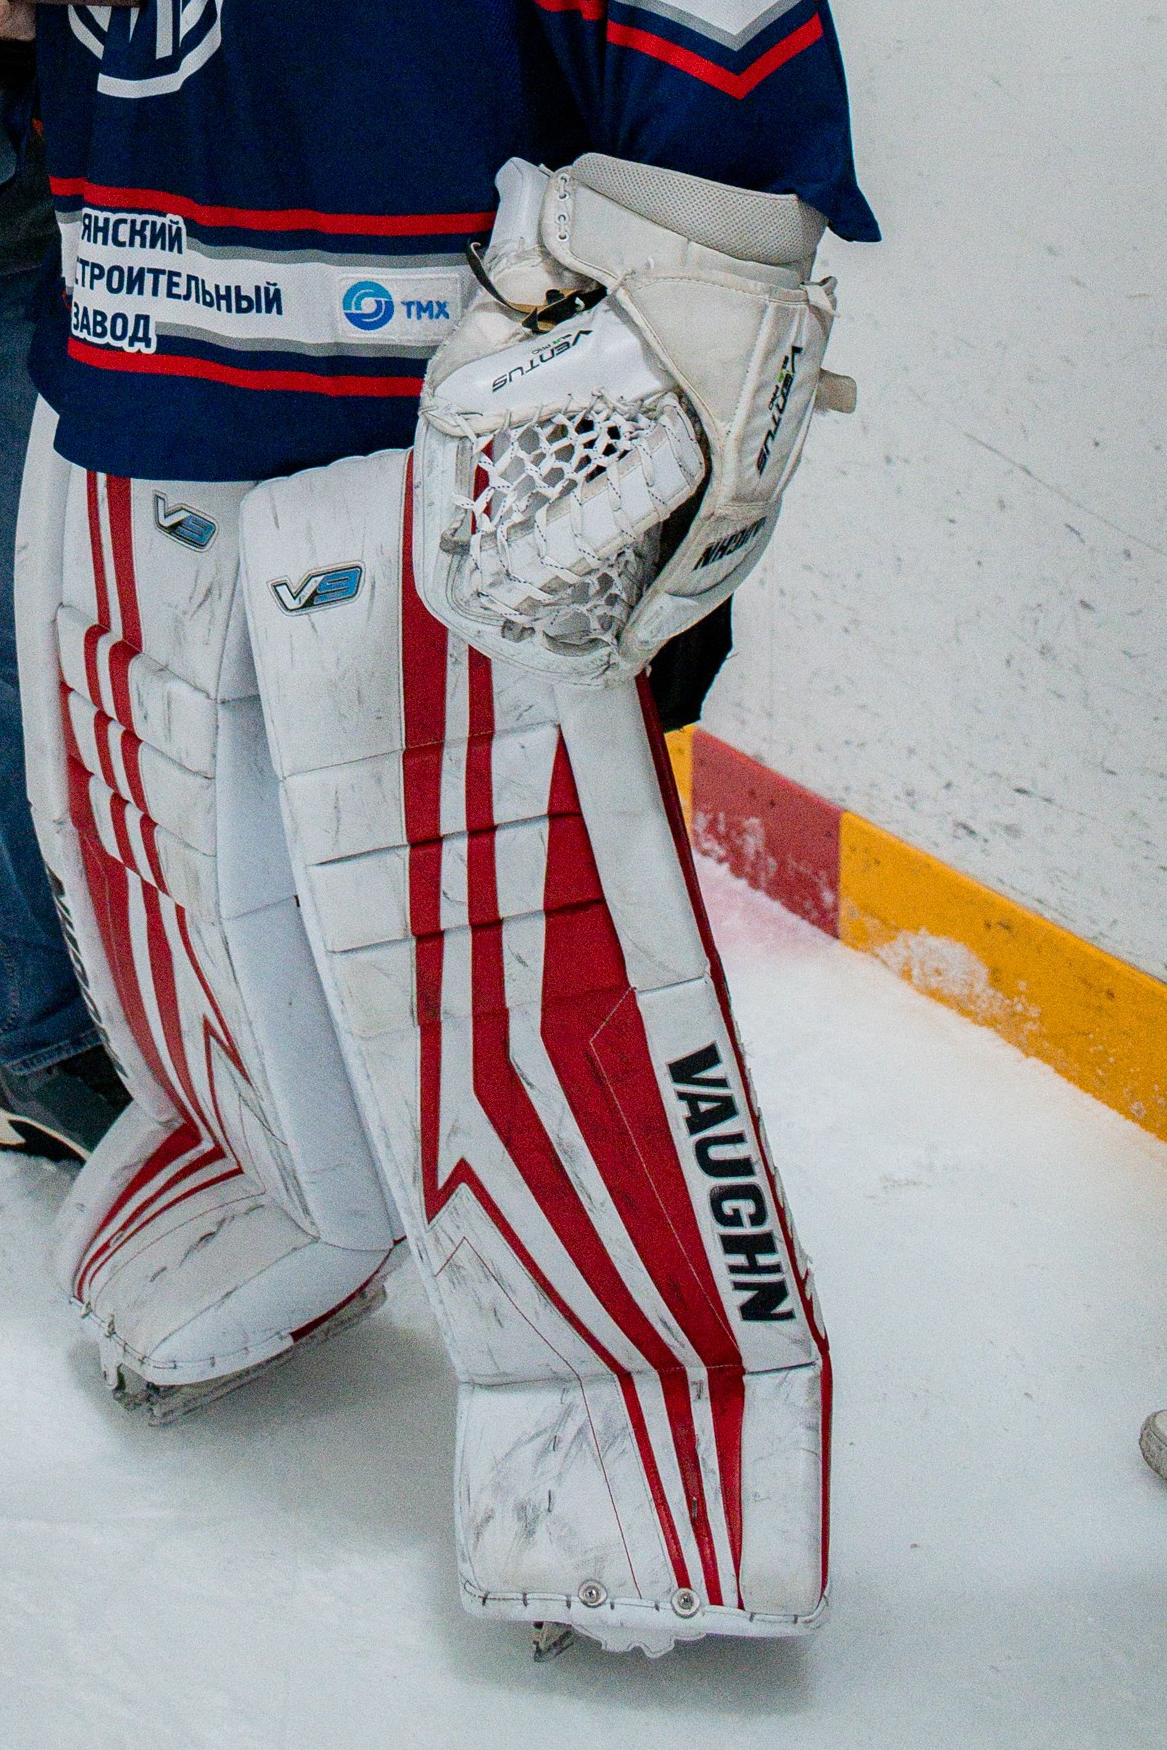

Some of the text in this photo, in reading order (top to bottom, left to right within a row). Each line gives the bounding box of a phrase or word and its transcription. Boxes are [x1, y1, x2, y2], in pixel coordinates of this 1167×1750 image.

[81, 212, 183, 255] ЯНСКИЙ
[75, 255, 284, 316] ТРОИТЕЛЬНЫЙ
[72, 300, 153, 349] ЗАВОД
[491, 329, 593, 393] VENTUS
[667, 1040, 797, 1324] VAUGHN
